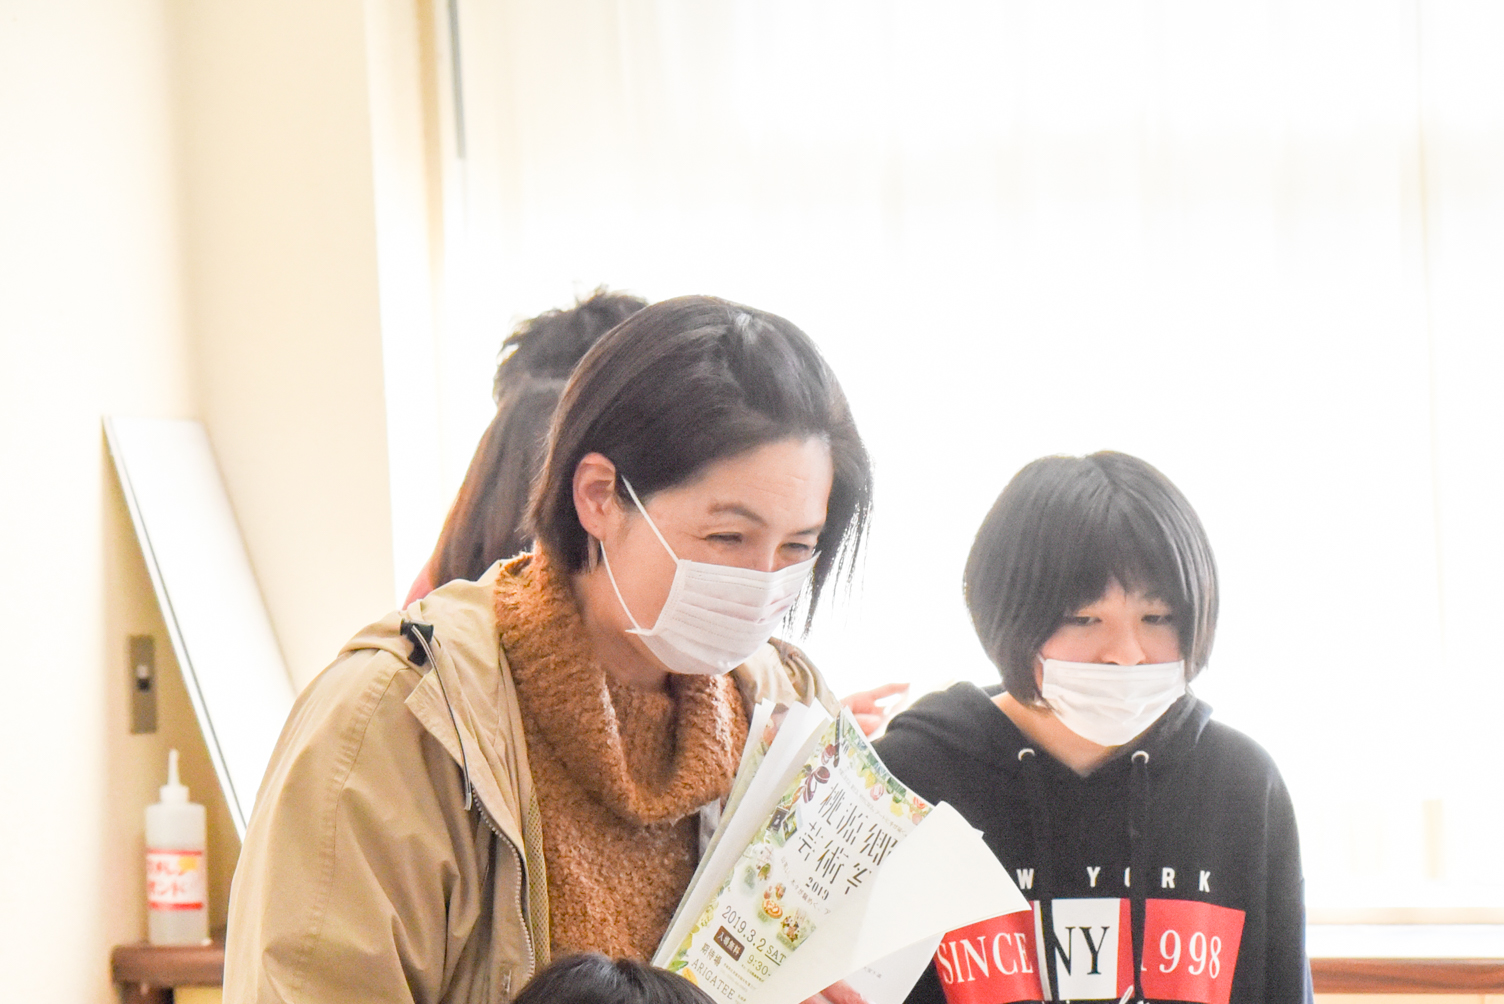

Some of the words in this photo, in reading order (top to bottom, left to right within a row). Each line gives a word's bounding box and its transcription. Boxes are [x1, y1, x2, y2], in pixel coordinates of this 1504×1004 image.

[805, 876, 830, 901] 2019
[722, 905, 767, 952] 2019.3.2
[767, 945, 787, 964] SAT
[937, 932, 1033, 984] SINCE
[1141, 929, 1222, 979] 998
[691, 958, 736, 1000] ARIGATEE
